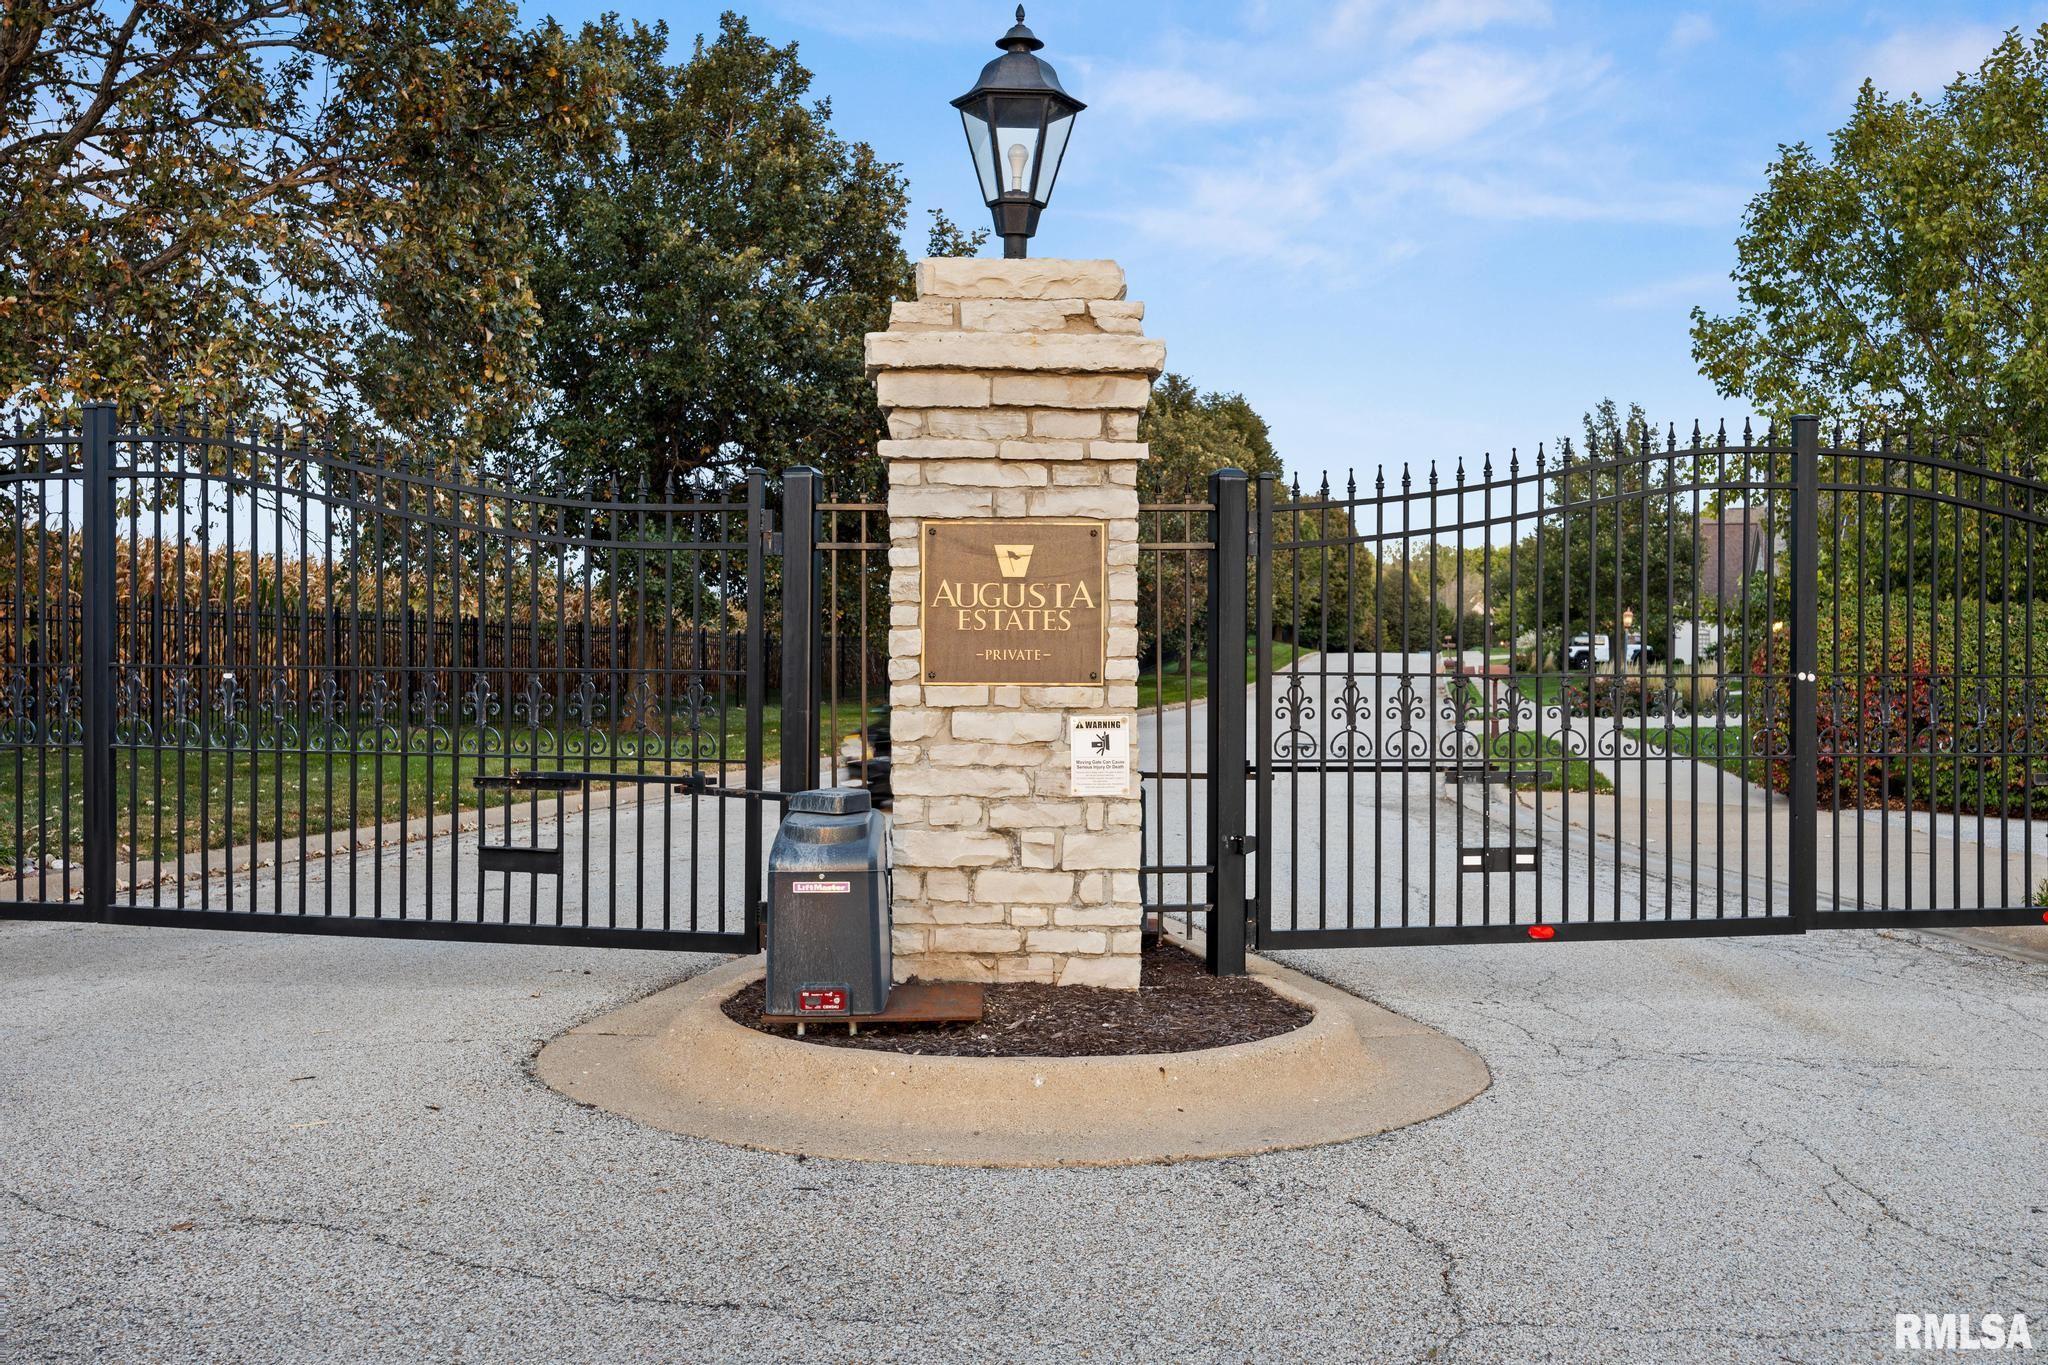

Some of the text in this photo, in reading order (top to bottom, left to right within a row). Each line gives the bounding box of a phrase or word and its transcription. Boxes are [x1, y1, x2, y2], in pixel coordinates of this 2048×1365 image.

[931, 579, 1096, 609] AUGUSTA
[958, 609, 1072, 631] ESTATES
[1085, 721, 1121, 729] WARNING
